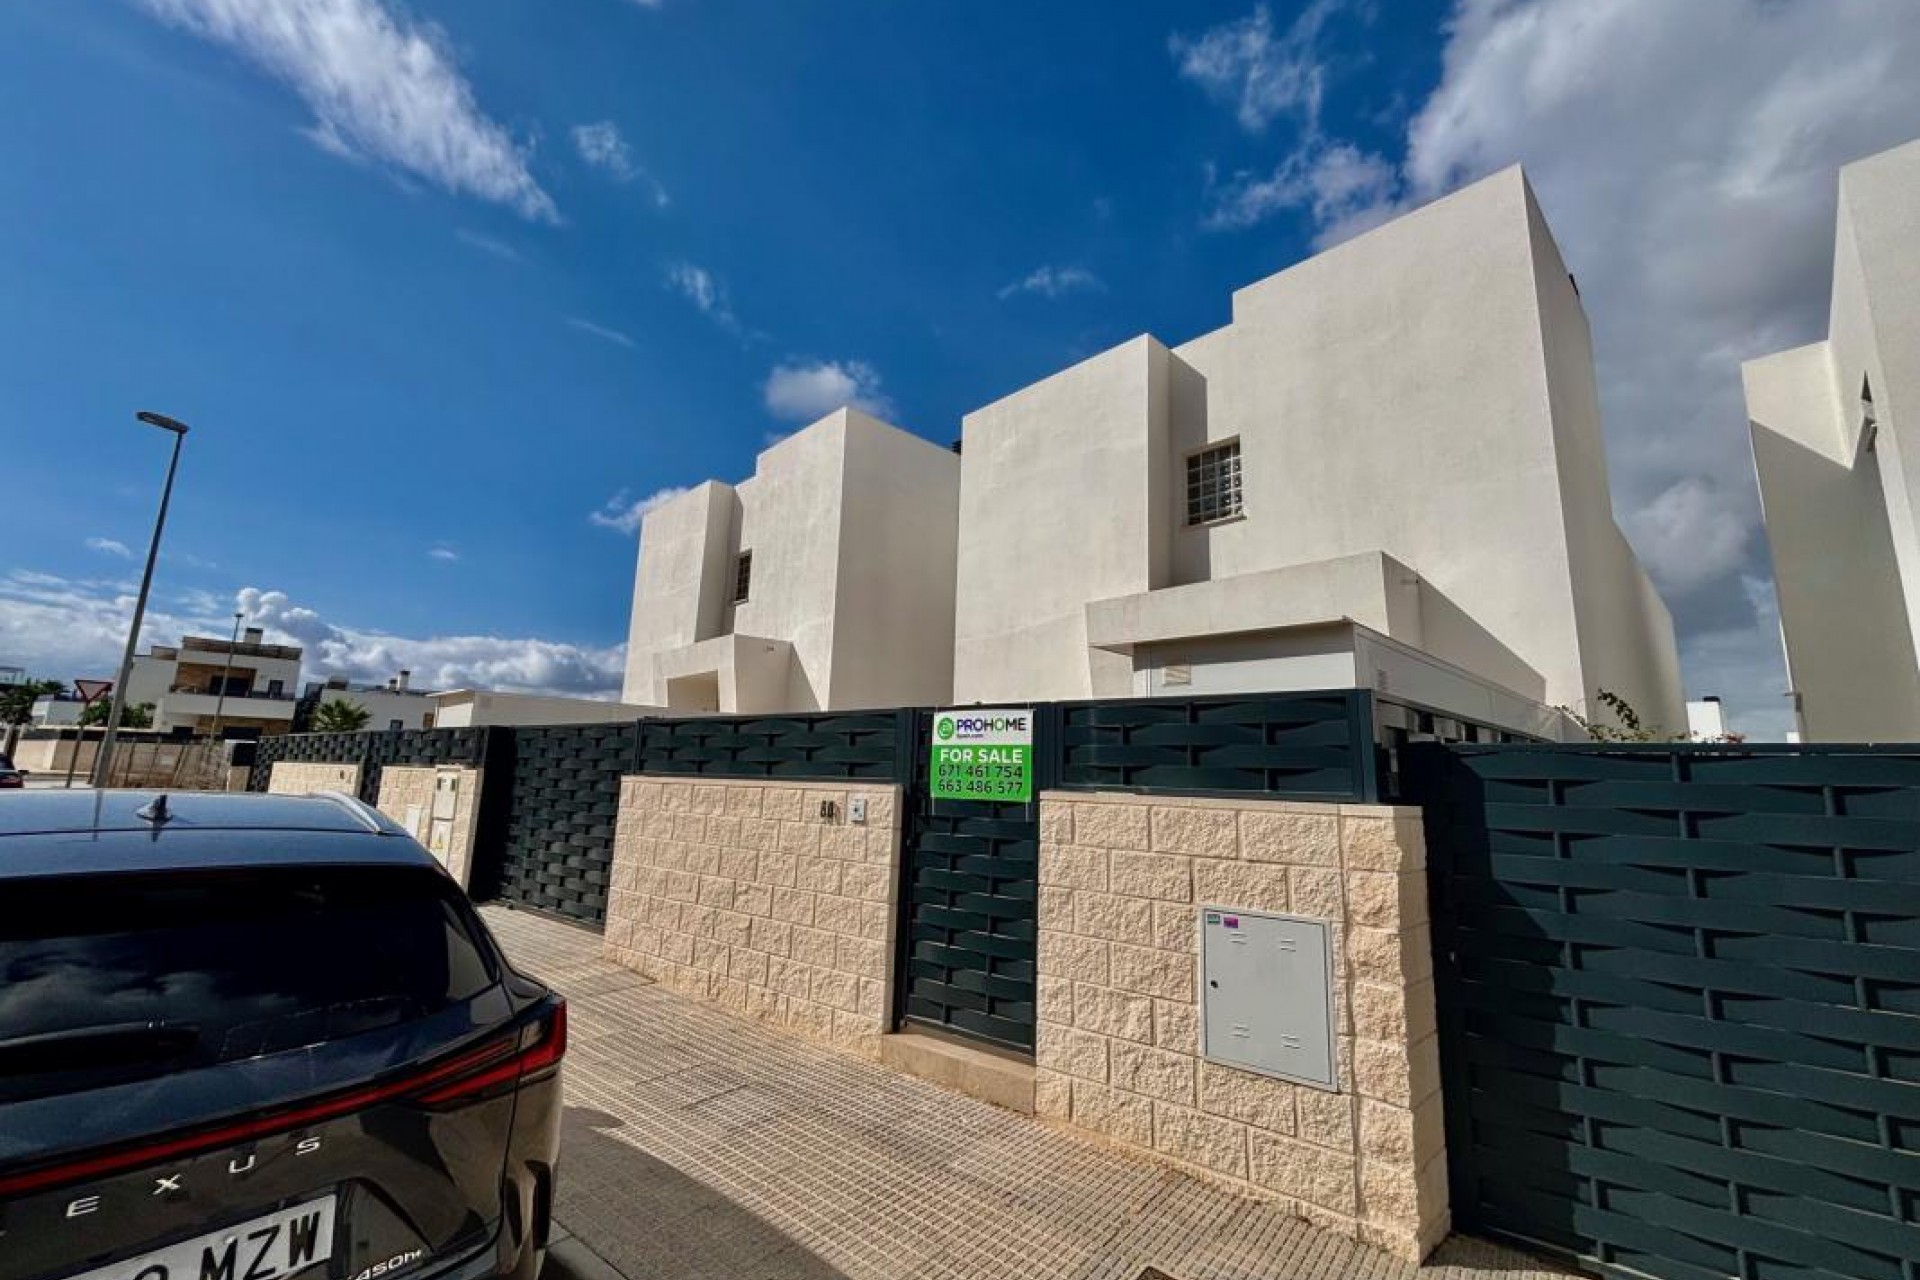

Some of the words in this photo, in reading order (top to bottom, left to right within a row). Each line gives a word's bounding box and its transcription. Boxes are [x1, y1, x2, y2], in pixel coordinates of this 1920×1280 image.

[956, 717, 1027, 732] PROHOME
[940, 747, 973, 763] FOR
[978, 748, 1023, 764] SALE
[938, 765, 961, 777] 671
[966, 766, 992, 778] 461
[995, 766, 1023, 778] 754
[938, 779, 962, 793] 663
[967, 781, 992, 794] 486
[997, 782, 1023, 795] 577
[0, 1136, 321, 1236] EXUS
[201, 1210, 321, 1280] MZW
